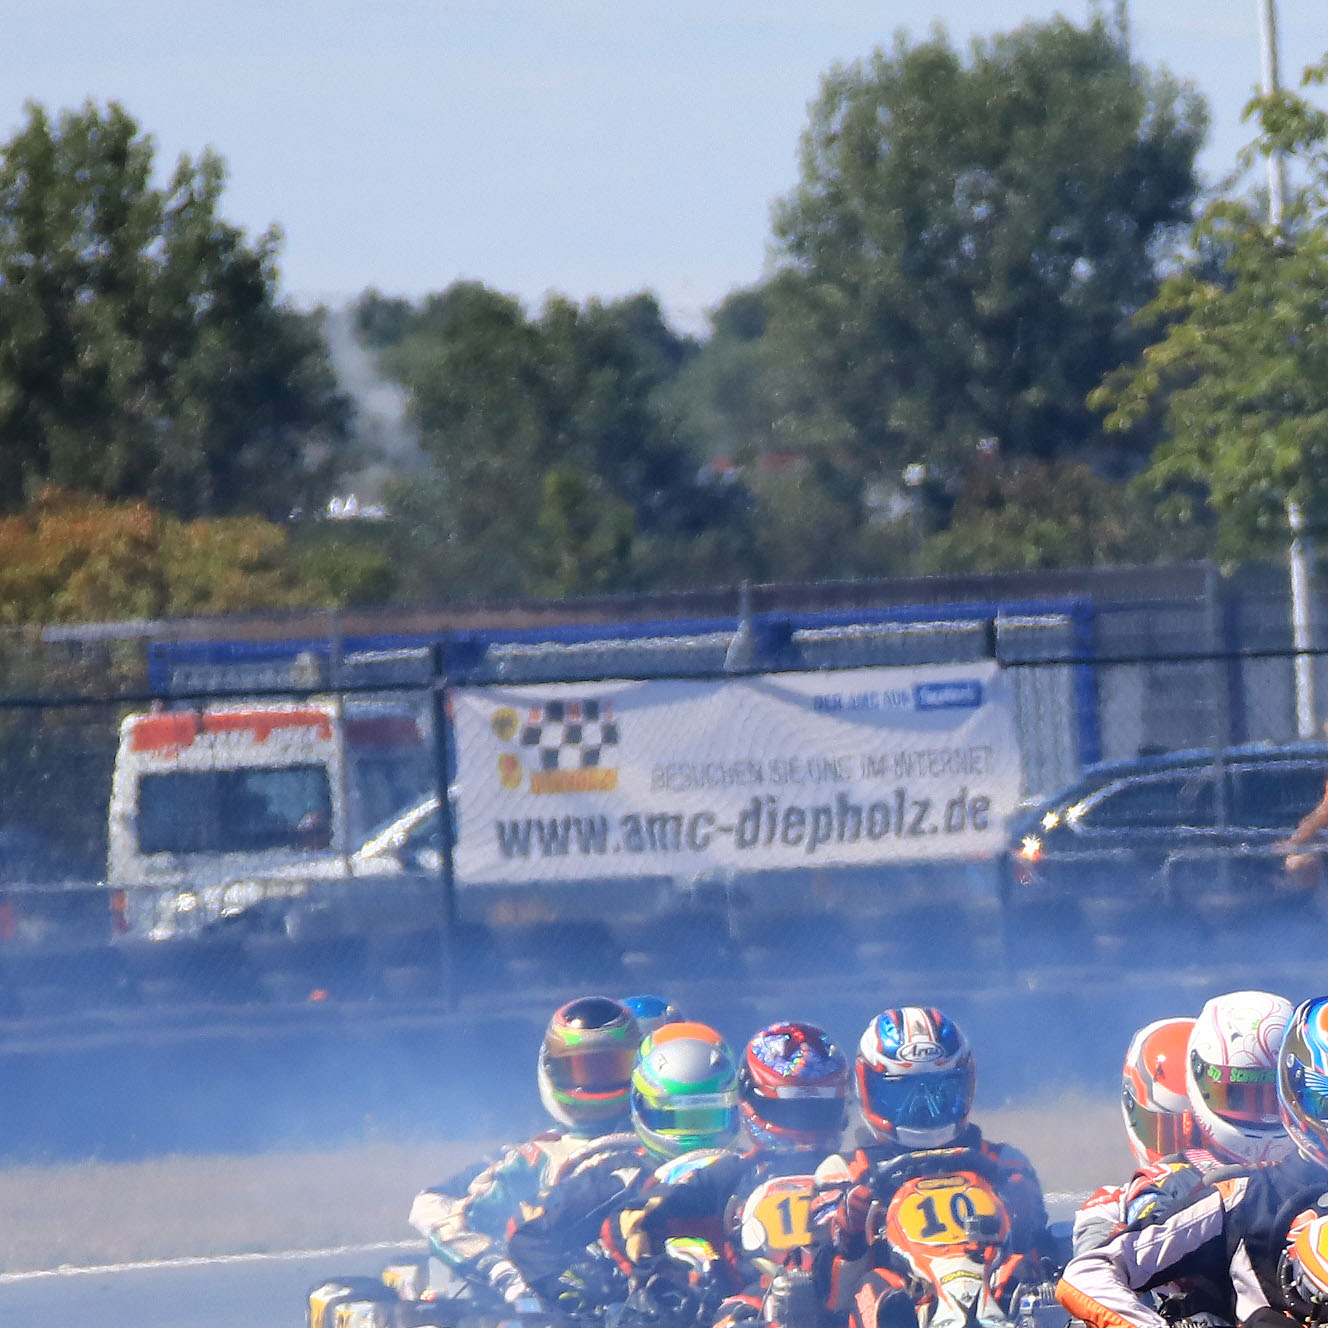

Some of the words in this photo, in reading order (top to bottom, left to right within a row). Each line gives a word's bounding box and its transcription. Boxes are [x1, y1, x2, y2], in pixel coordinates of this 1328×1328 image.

[650, 758, 763, 790] BESUCHEN
[893, 745, 992, 777] INTERNET
[496, 787, 990, 857] www.amc-diepholz.de
[917, 1192, 976, 1238] 10
